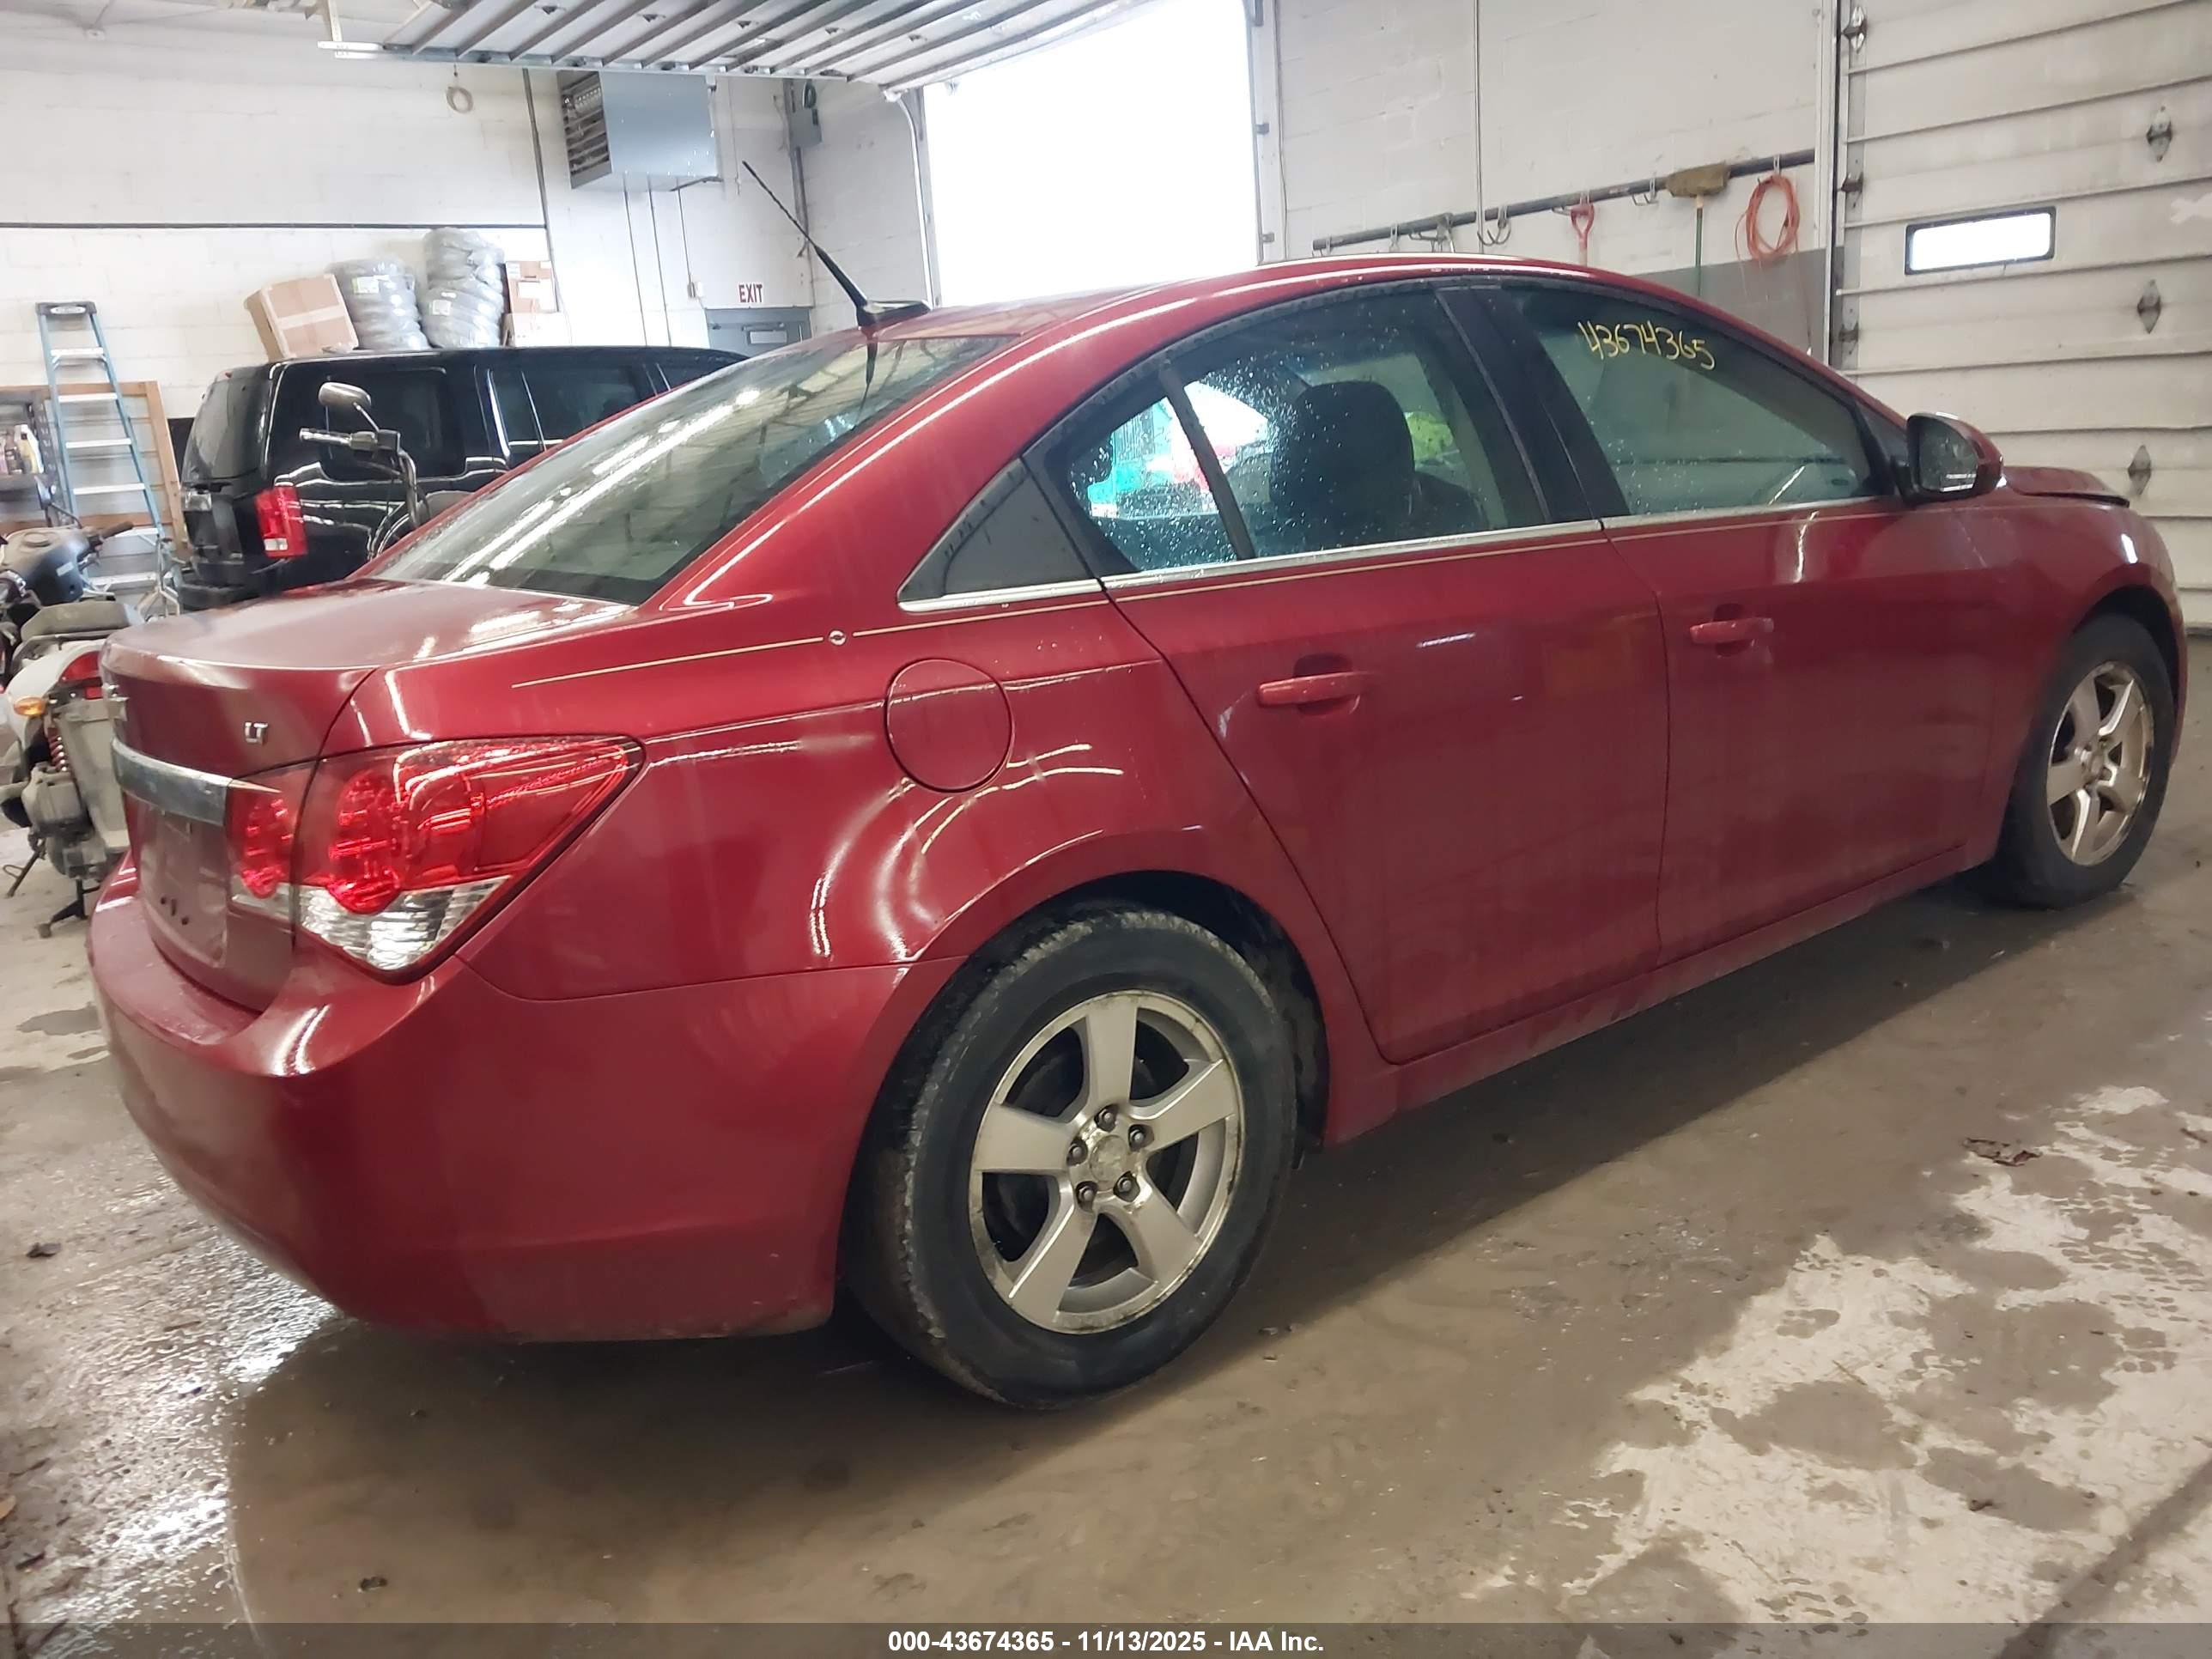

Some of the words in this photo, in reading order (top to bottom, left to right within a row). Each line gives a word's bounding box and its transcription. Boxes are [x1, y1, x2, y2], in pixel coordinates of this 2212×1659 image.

[738, 283, 763, 303] EXIT
[1577, 320, 1715, 370] 43674365
[244, 721, 269, 744] LT
